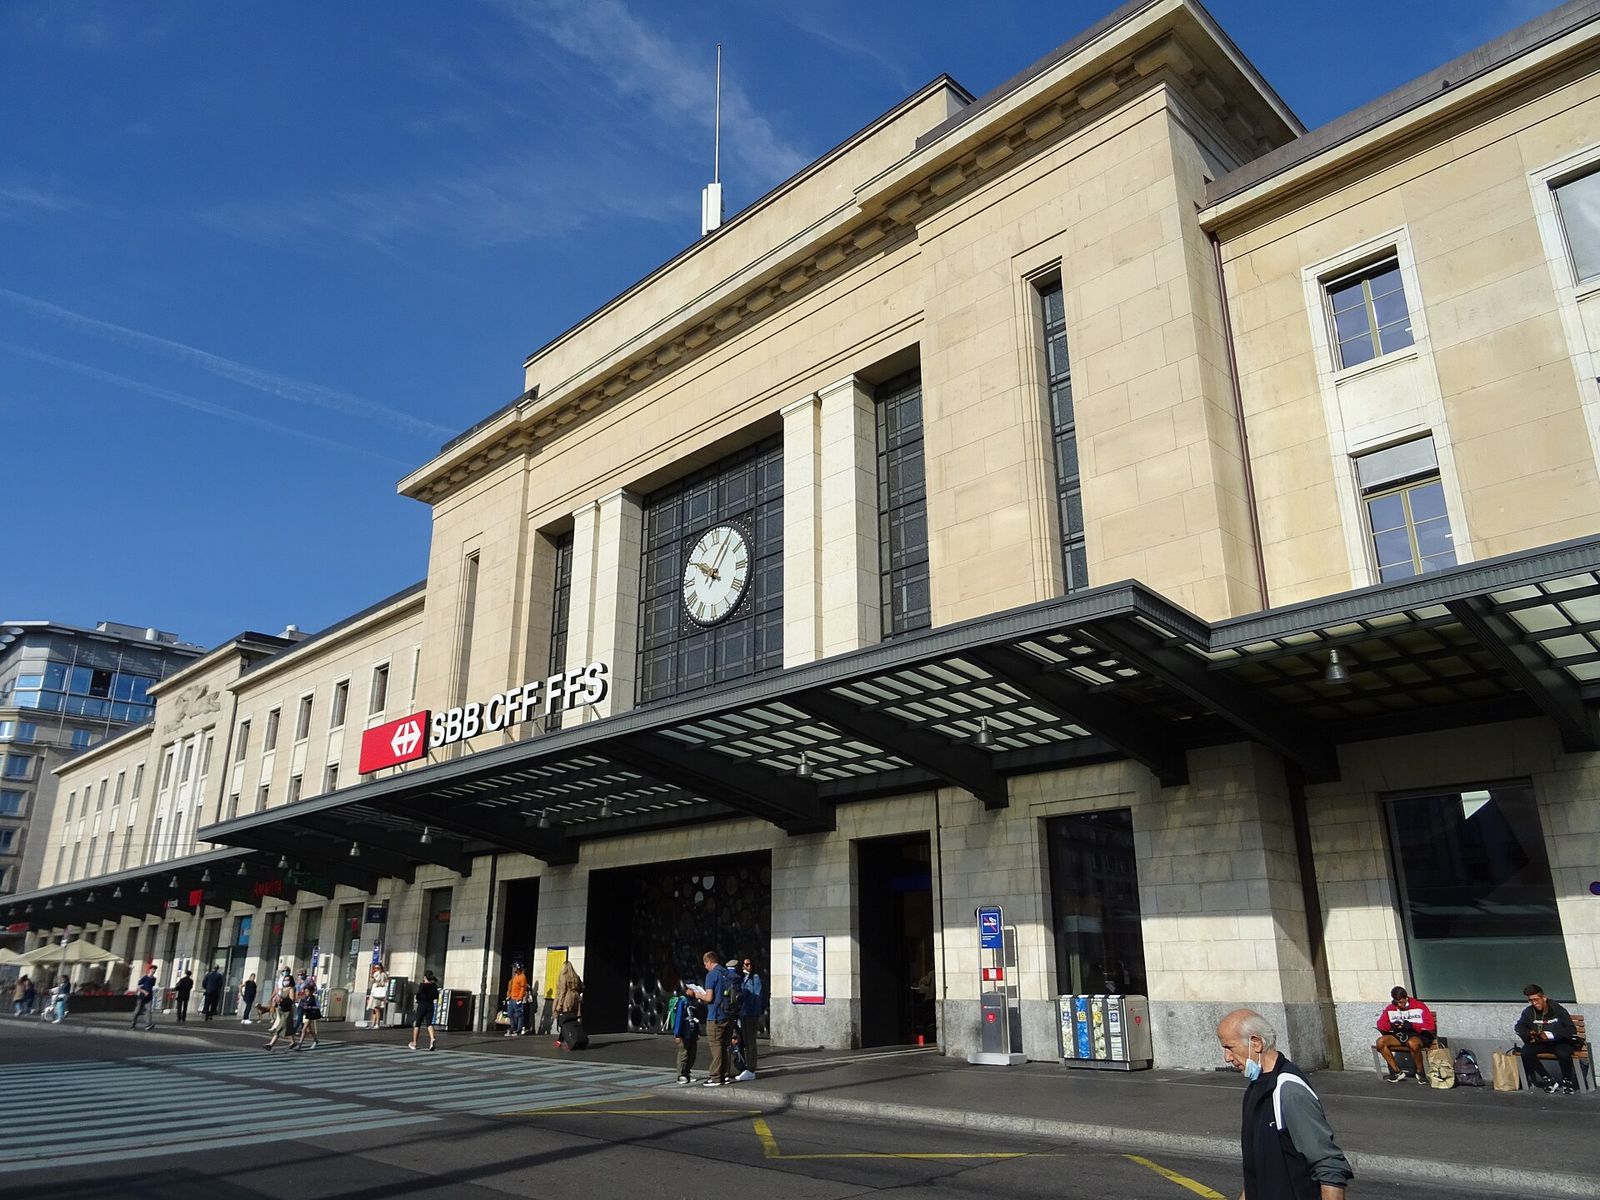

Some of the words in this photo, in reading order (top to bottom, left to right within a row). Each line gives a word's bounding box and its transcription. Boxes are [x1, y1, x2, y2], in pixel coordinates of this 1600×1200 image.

[429, 702, 483, 748] SBB
[485, 681, 541, 732] CFF
[545, 661, 608, 715] FFS
